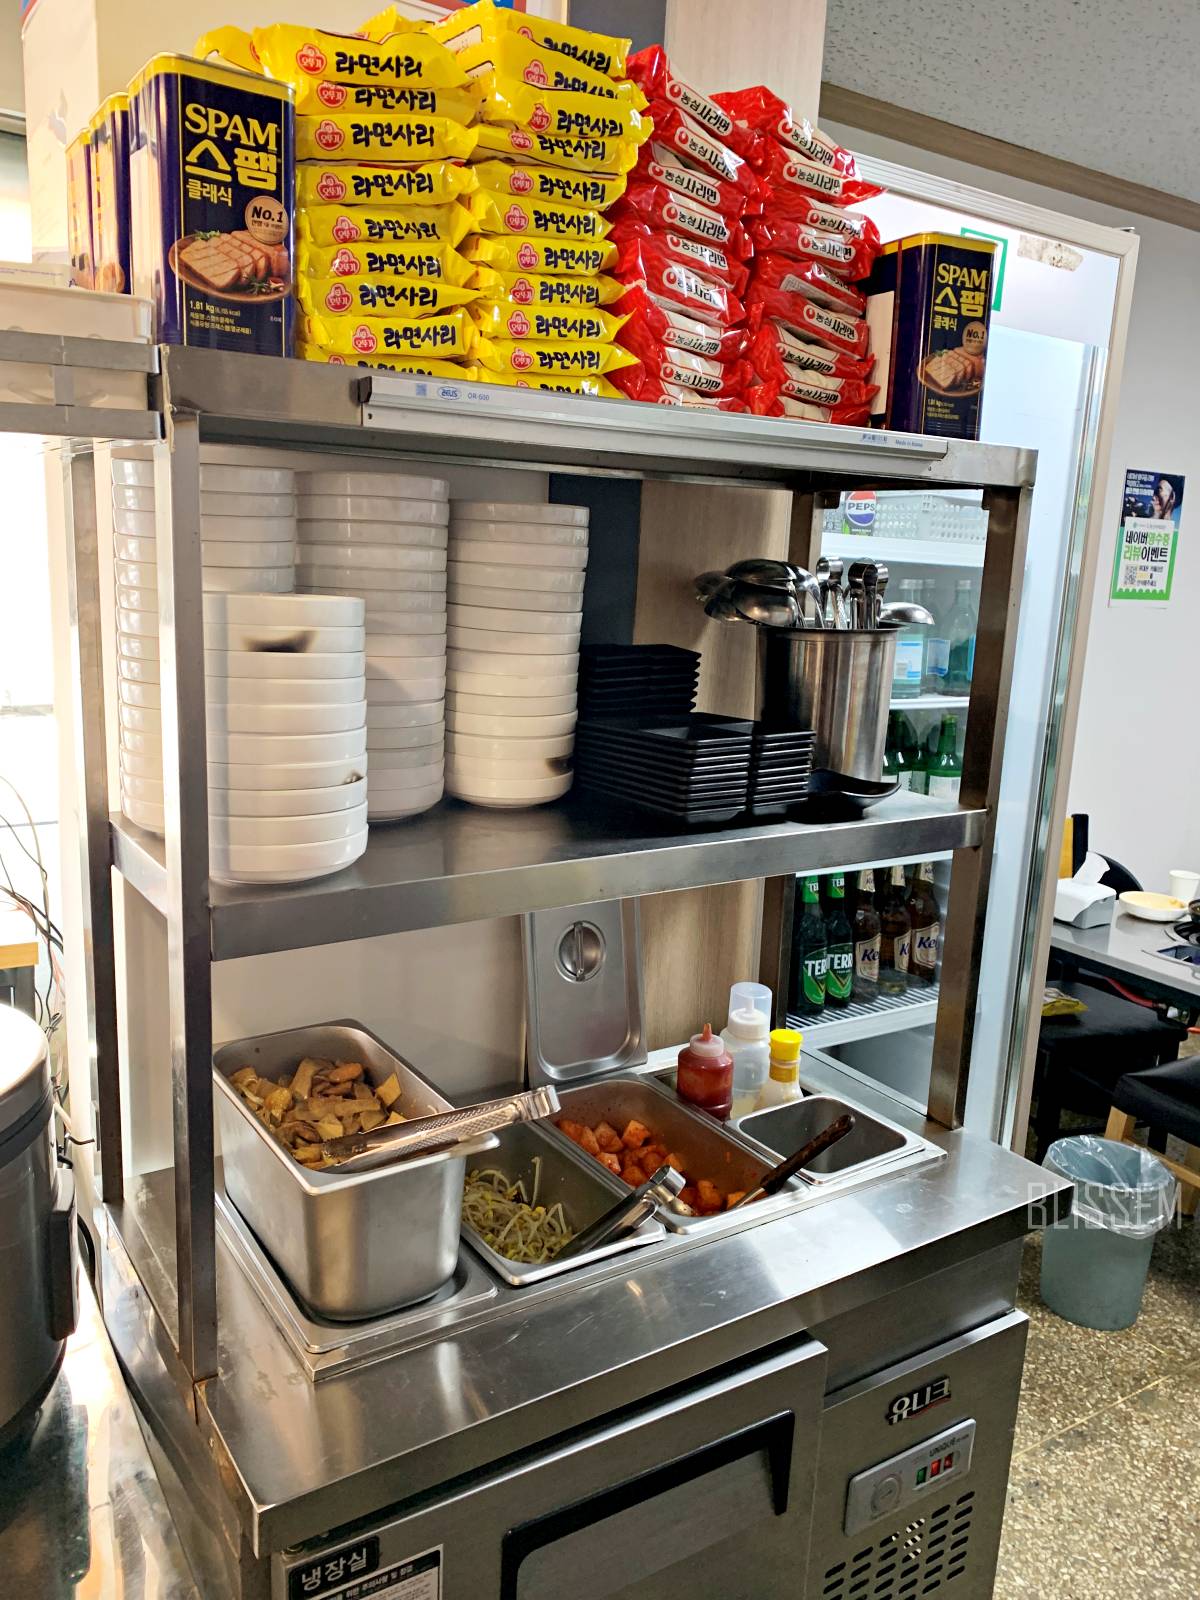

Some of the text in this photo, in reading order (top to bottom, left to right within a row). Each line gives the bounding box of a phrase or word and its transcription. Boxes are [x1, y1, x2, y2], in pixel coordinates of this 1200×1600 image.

[335, 52, 422, 78] 라면사리
[185, 103, 278, 151] SPAM
[350, 122, 434, 147] 라면사리
[558, 110, 624, 138] 라면사리
[536, 134, 606, 160] 라면사리
[185, 139, 277, 191] 스팸
[186, 178, 232, 207] 클래식
[352, 172, 434, 198] 라면사리
[538, 174, 606, 202] 라면사리
[252, 206, 284, 222] No.1
[533, 210, 596, 236] 라면사리
[364, 218, 440, 240] 라면사리
[366, 252, 442, 278] 라면사리
[544, 247, 604, 270] 라면사리
[937, 262, 988, 290] SPAM
[358, 284, 438, 308] 라면사리
[540, 281, 600, 305] 라면사리
[934, 286, 984, 318] 스팸
[383, 325, 456, 350] 라면사리
[536, 315, 600, 338] 라면사리
[536, 350, 600, 370] 라면사리
[848, 502, 877, 512] PEPS
[302, 1547, 366, 1592] 냉장실
